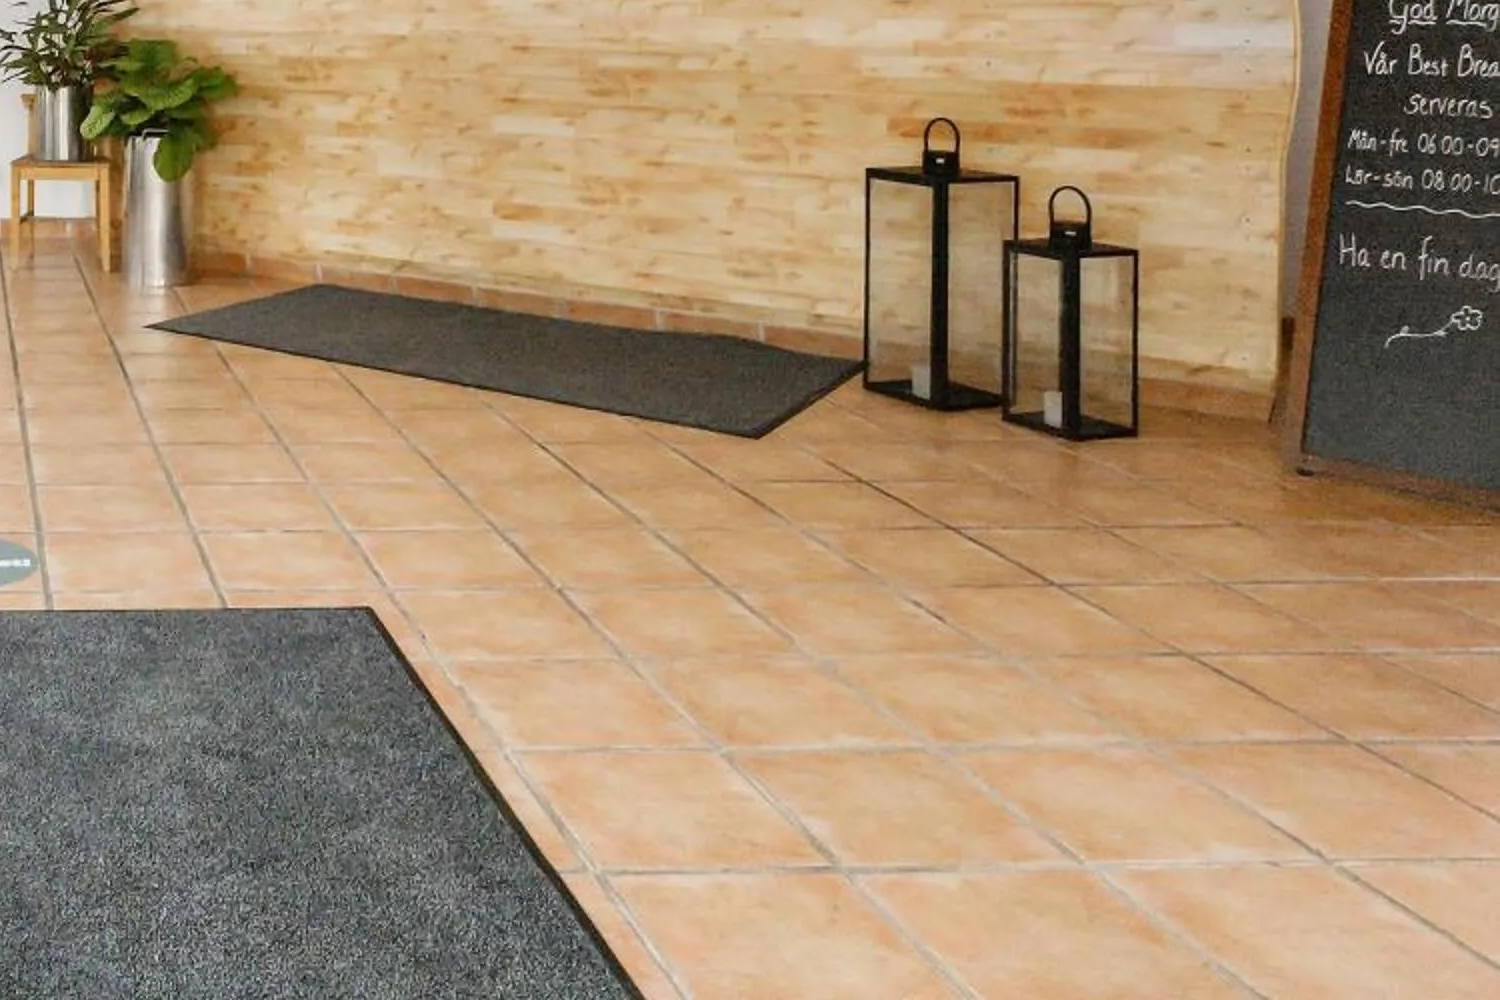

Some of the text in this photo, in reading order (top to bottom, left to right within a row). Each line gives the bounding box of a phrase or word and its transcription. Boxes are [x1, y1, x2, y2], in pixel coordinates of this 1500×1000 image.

[1363, 41, 1398, 75] Vår
[1407, 43, 1449, 77] Best
[1403, 93, 1493, 119] serveras
[1347, 127, 1409, 157] Mån-fre
[1339, 232, 1500, 293] Ha en fin dag
